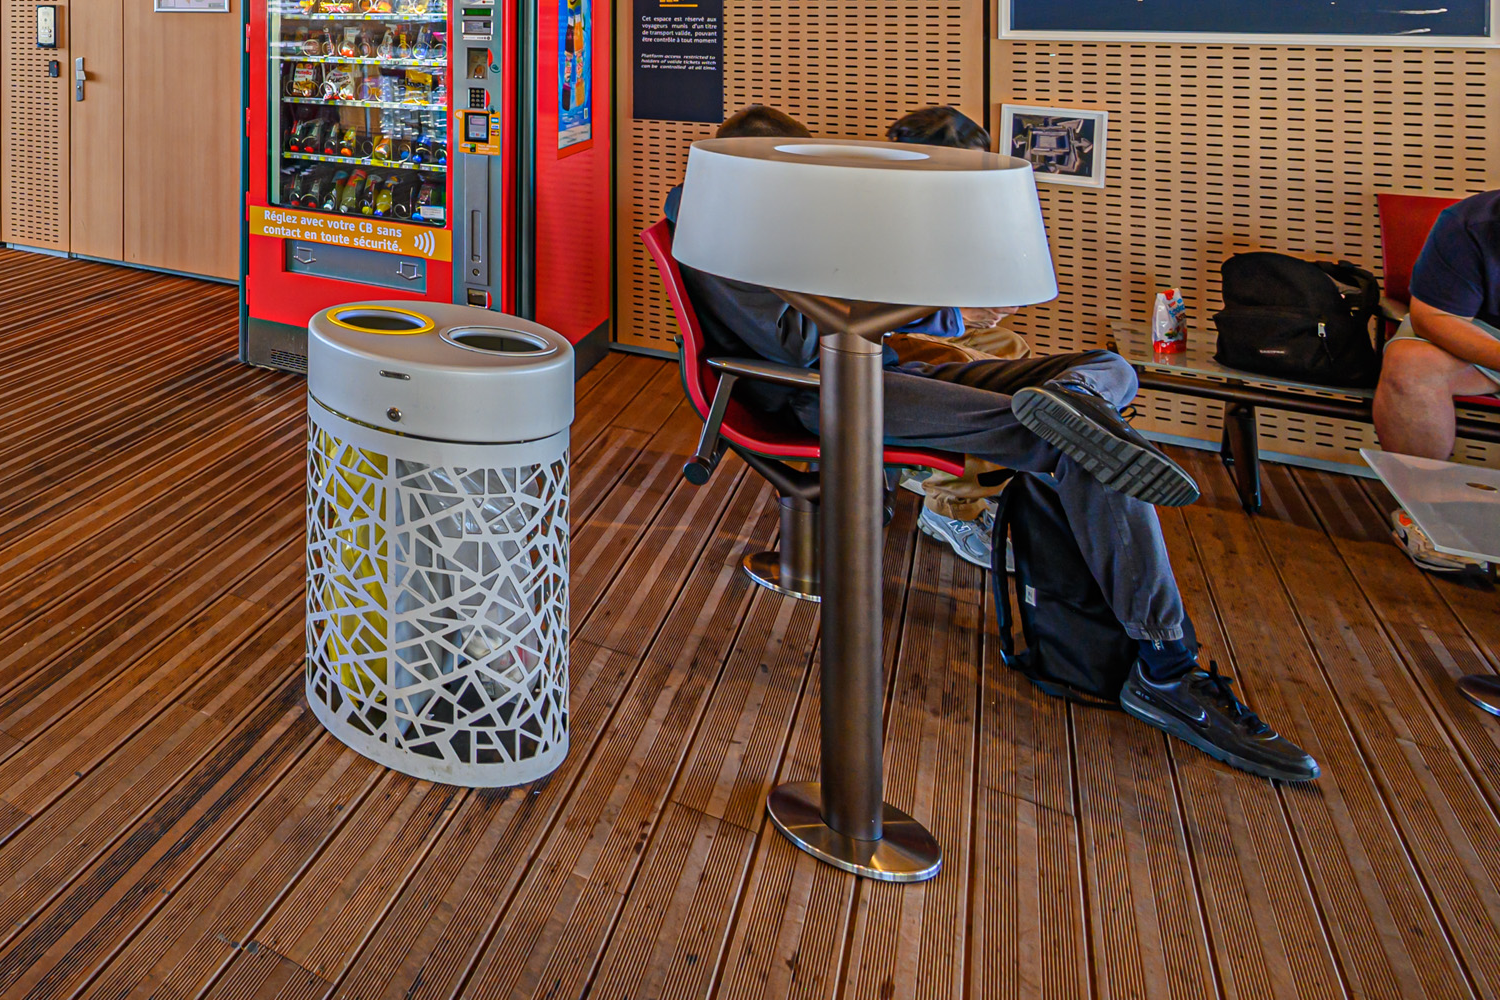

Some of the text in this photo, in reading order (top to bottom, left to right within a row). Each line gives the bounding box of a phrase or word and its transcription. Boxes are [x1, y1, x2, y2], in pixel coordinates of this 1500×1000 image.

[264, 210, 402, 238] Réglez avec votre CB sans
[263, 225, 402, 252] contact en toute sécurité.
